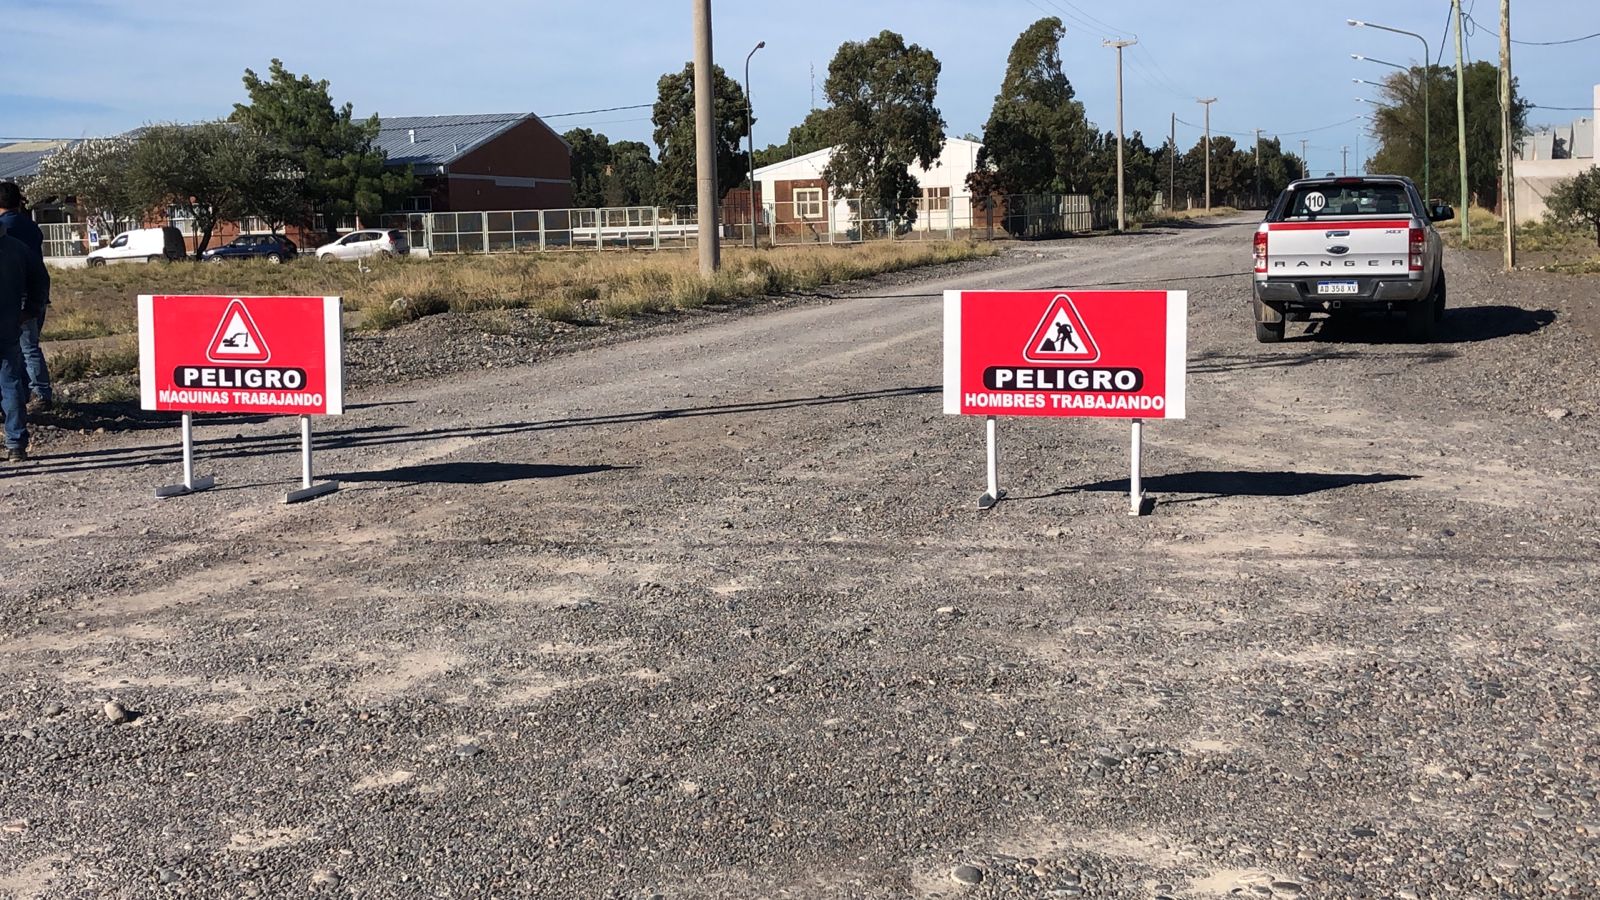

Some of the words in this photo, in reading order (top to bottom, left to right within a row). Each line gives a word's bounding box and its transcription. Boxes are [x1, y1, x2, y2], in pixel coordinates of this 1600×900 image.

[1306, 195, 1324, 208] 110
[1274, 259, 1404, 268] RANGER
[183, 367, 302, 389] PELIGRO
[994, 368, 1137, 390] PELIGRO
[232, 391, 323, 407] TRABAJANDO
[964, 391, 1046, 408] HOMBRES
[1050, 393, 1165, 410] TRABAJANDO
